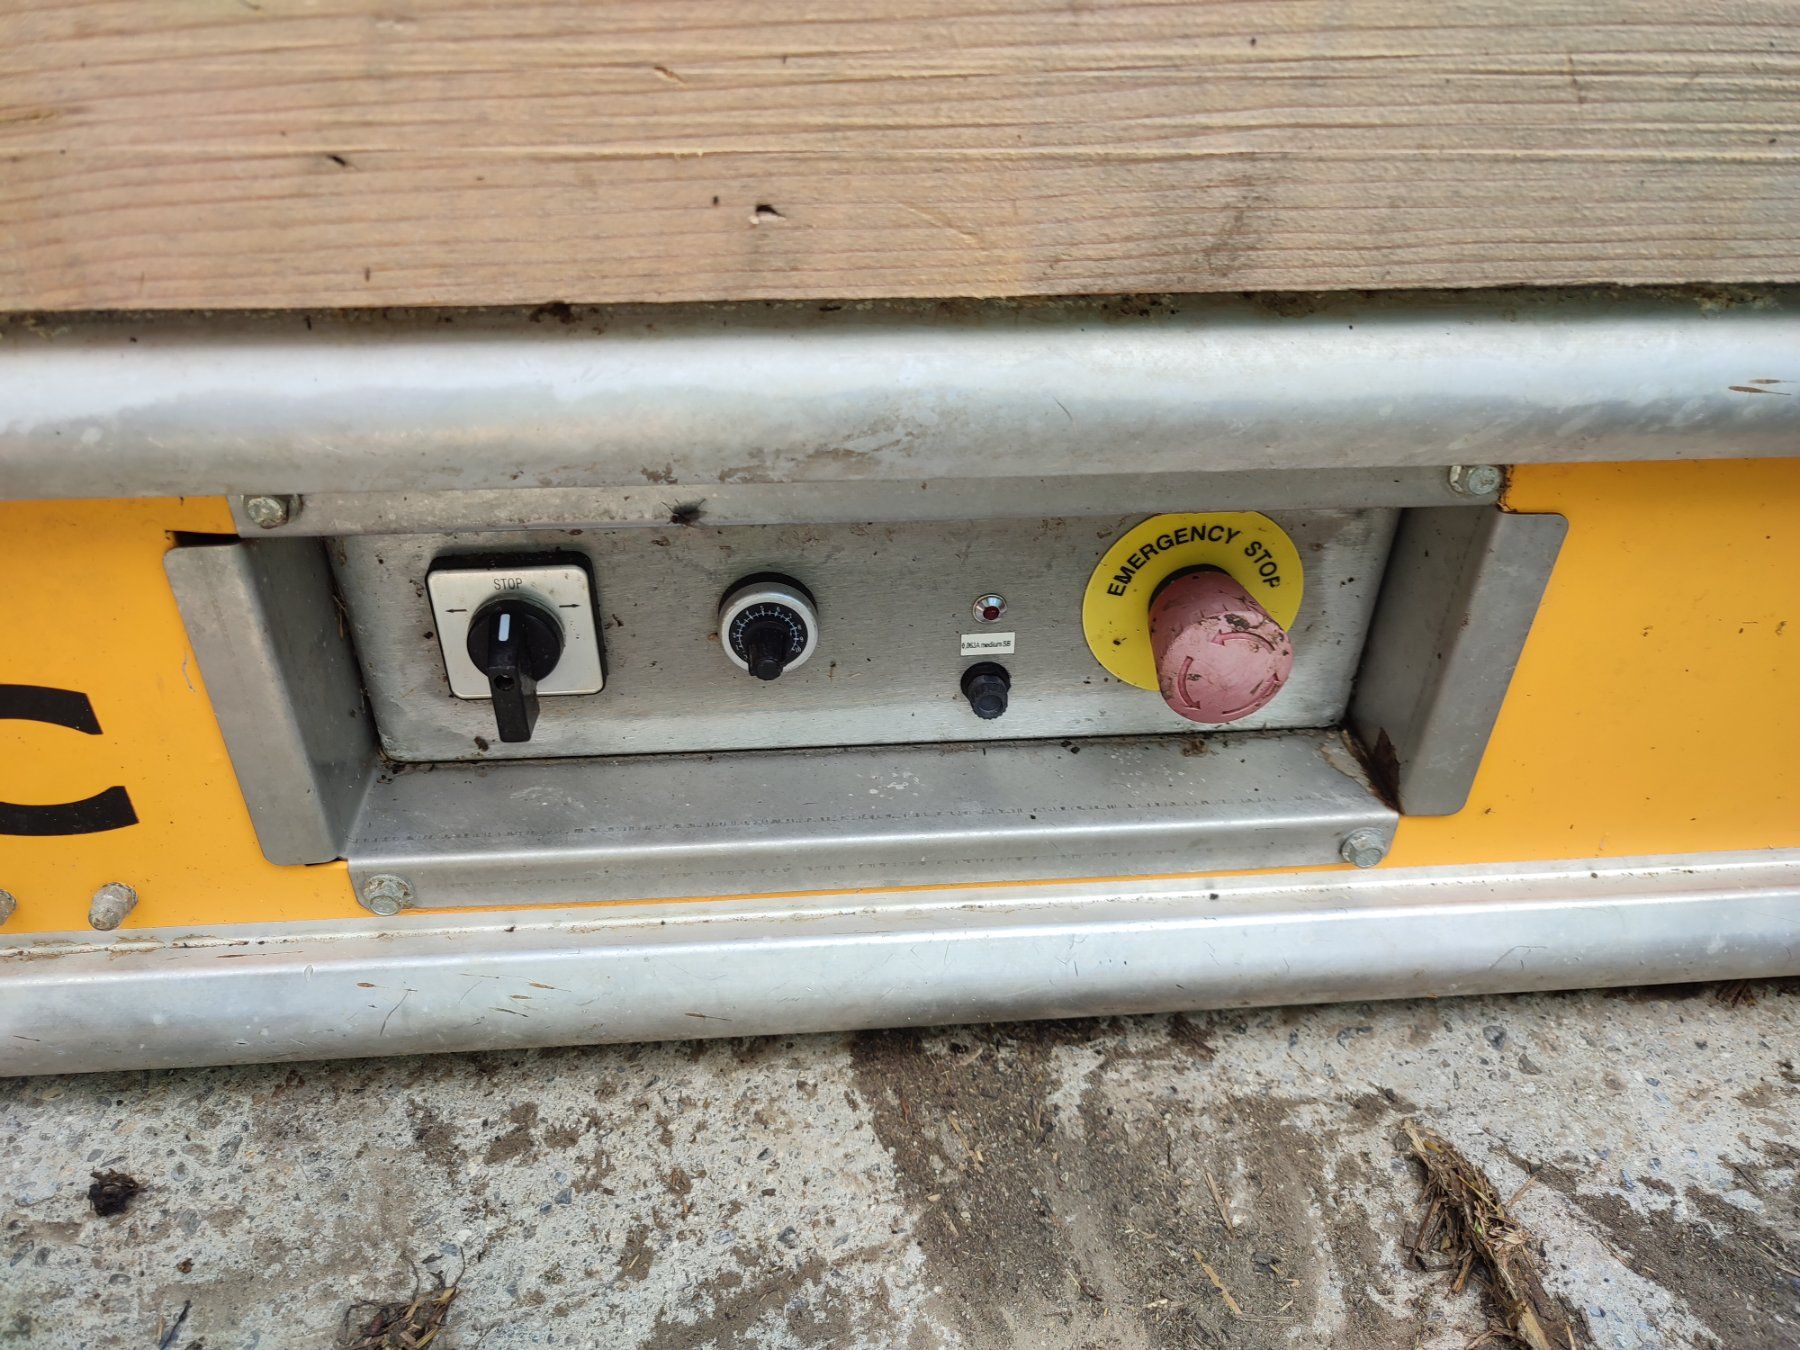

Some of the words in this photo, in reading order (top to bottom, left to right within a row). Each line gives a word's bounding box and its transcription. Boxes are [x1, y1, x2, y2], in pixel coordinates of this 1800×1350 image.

[1106, 525, 1242, 597] EMERGENCY
[1243, 540, 1282, 590] STOP
[493, 577, 523, 591] STOP
